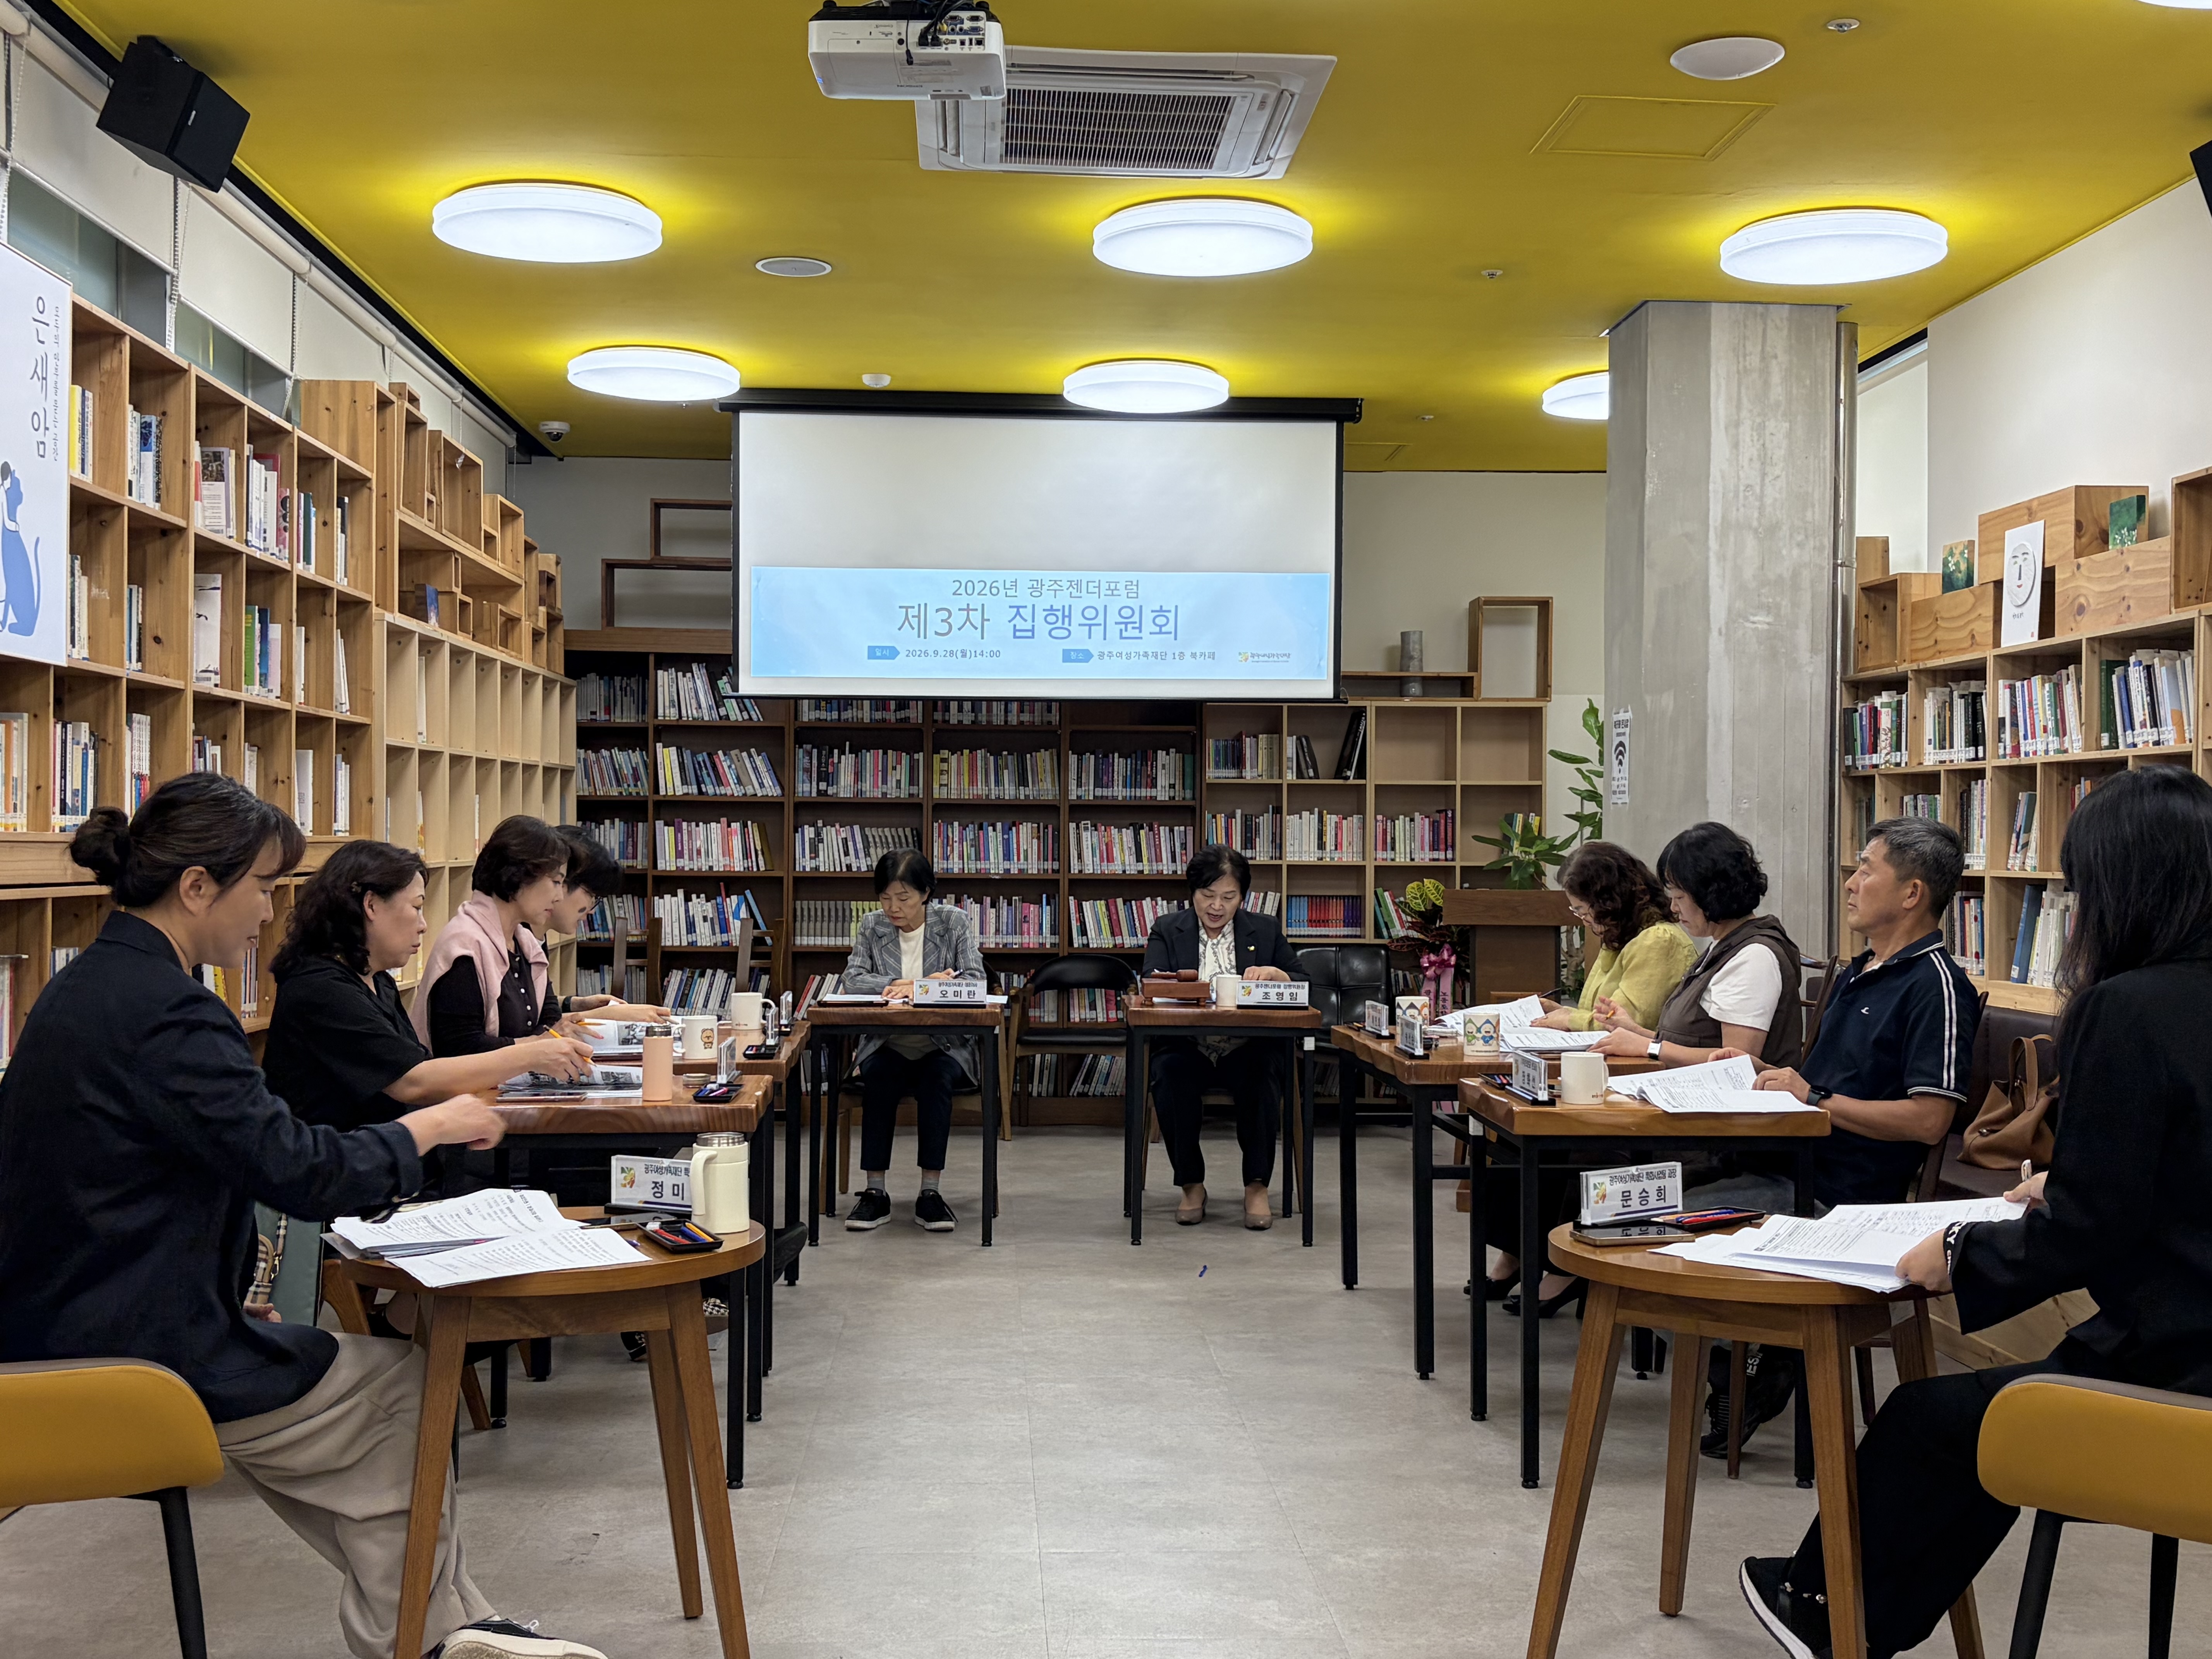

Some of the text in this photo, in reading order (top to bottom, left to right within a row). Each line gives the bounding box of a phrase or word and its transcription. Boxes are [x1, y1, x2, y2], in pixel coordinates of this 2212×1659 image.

[30, 296, 50, 458] 은새암
[952, 578, 1140, 599] 2026년 광주젠더포럼
[897, 603, 1178, 641] 제3차 집행위원회
[875, 648, 890, 656] 일시
[905, 649, 1001, 659] 2026.9.28(월)14:00
[1097, 651, 1216, 661] 광주여성가족재단 1층 북카페
[939, 990, 976, 999] 오미란
[1262, 991, 1297, 1001] 조영임
[1620, 1185, 1666, 1208] 문승희
